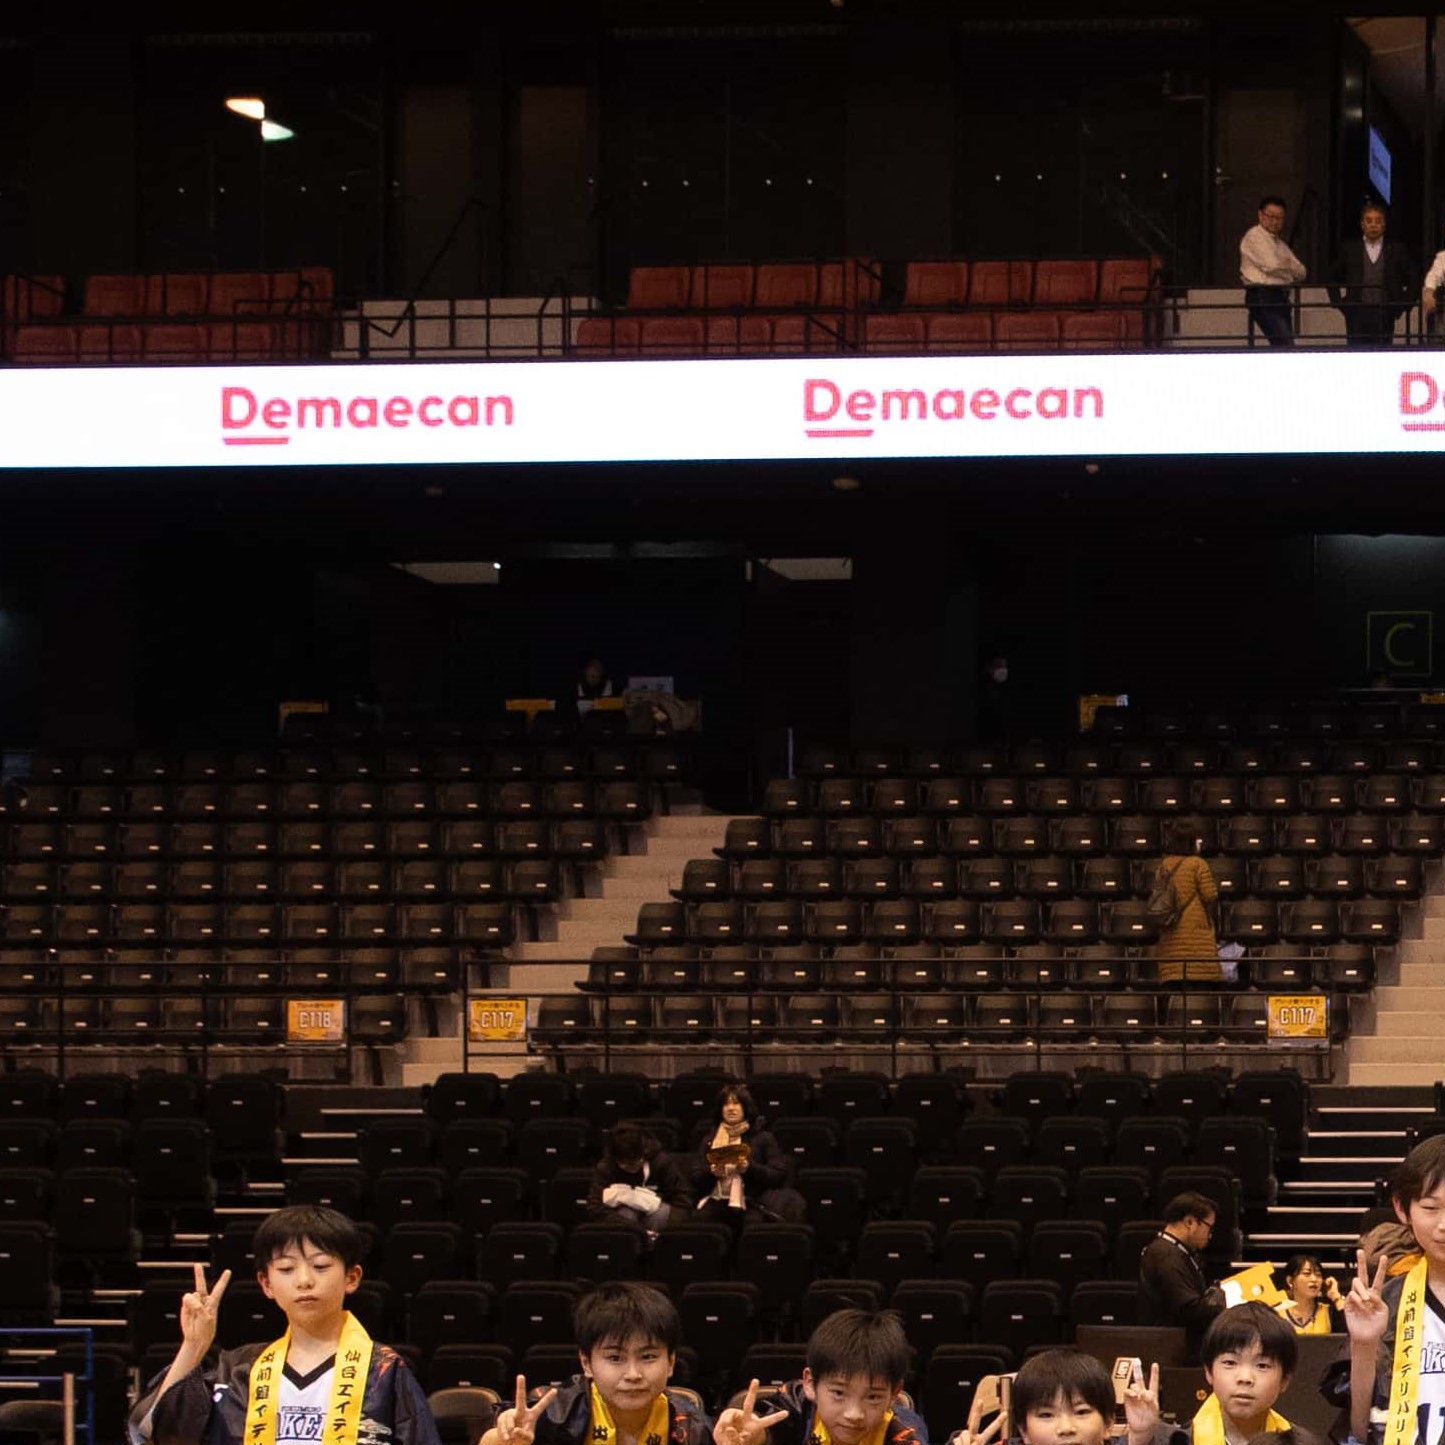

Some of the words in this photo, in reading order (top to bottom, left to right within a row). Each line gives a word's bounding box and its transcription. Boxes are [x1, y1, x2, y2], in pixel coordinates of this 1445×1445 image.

[222, 387, 513, 429] Demaecan
[804, 380, 1102, 421] Demaecan
[481, 1011, 513, 1028] C117
[1280, 1007, 1314, 1025] C117
